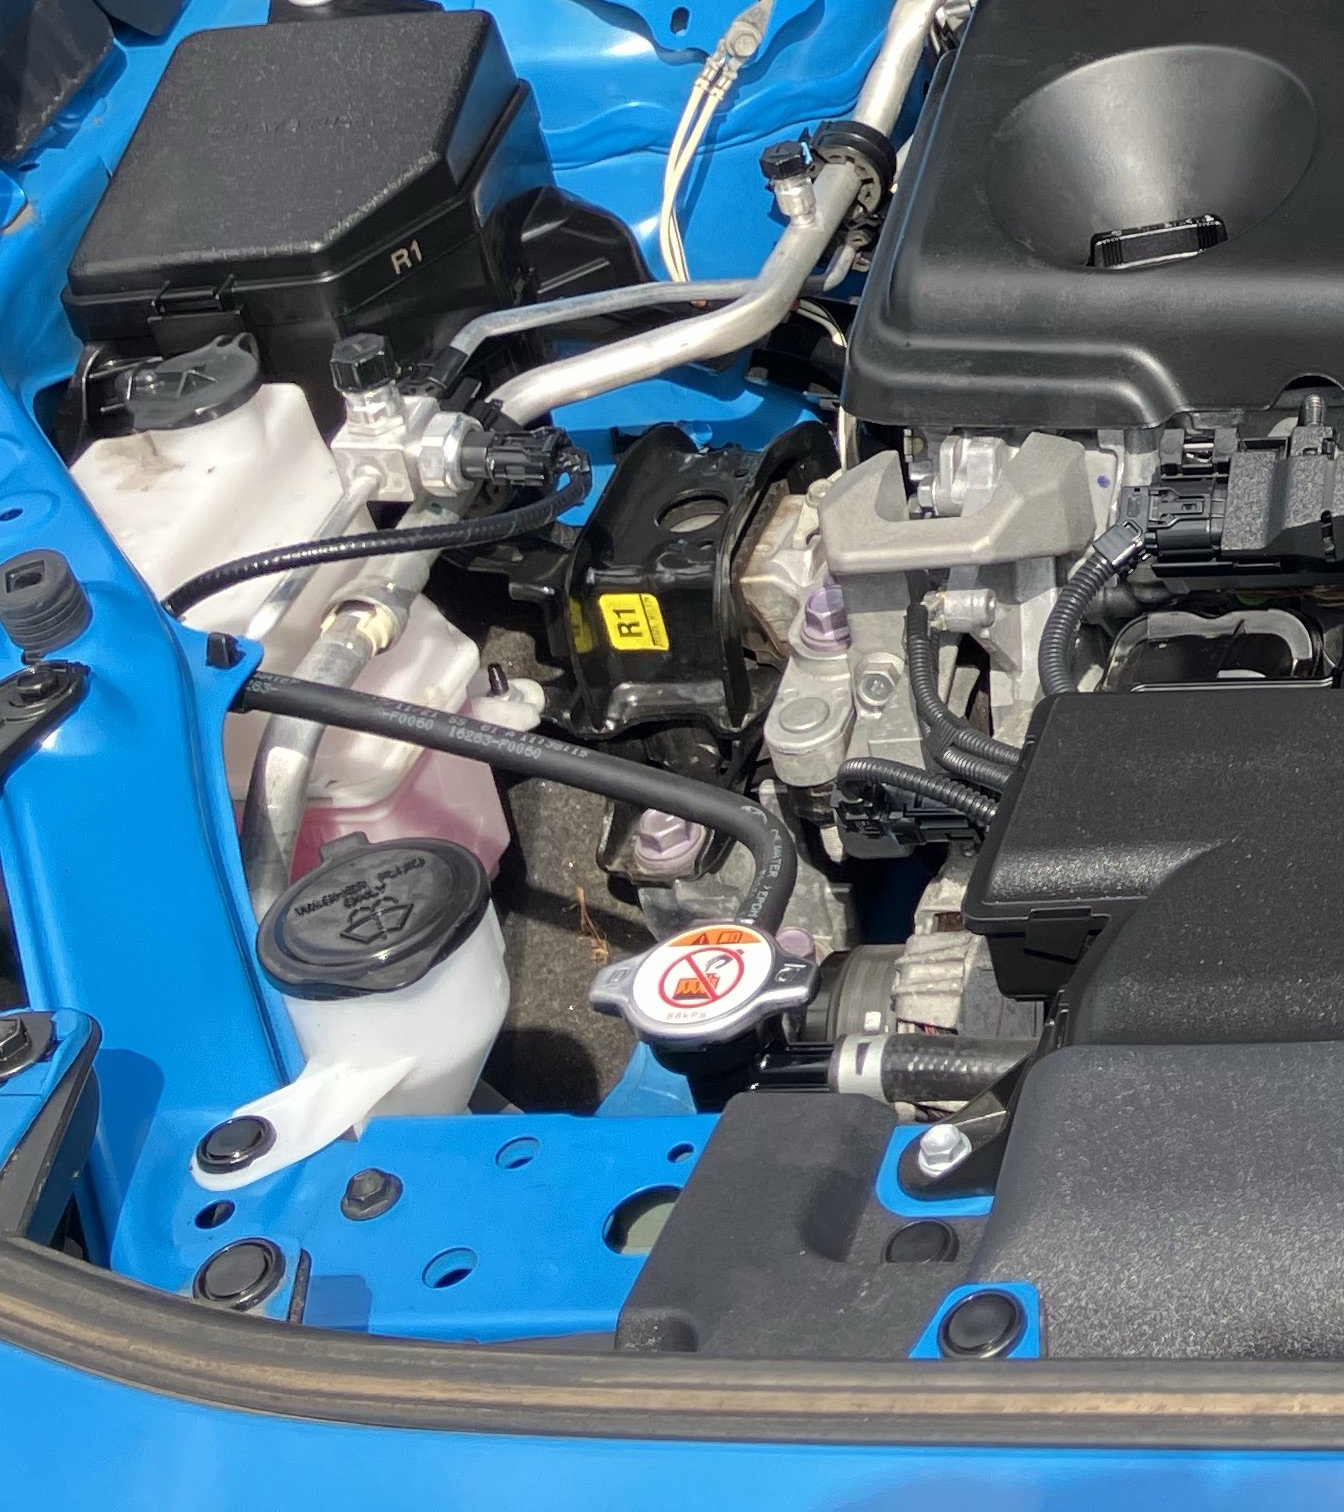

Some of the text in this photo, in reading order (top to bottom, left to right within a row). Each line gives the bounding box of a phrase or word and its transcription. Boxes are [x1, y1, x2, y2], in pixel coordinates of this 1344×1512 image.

[390, 239, 424, 275] R1
[612, 609, 643, 638] R1
[447, 724, 543, 759] 16283-F0060
